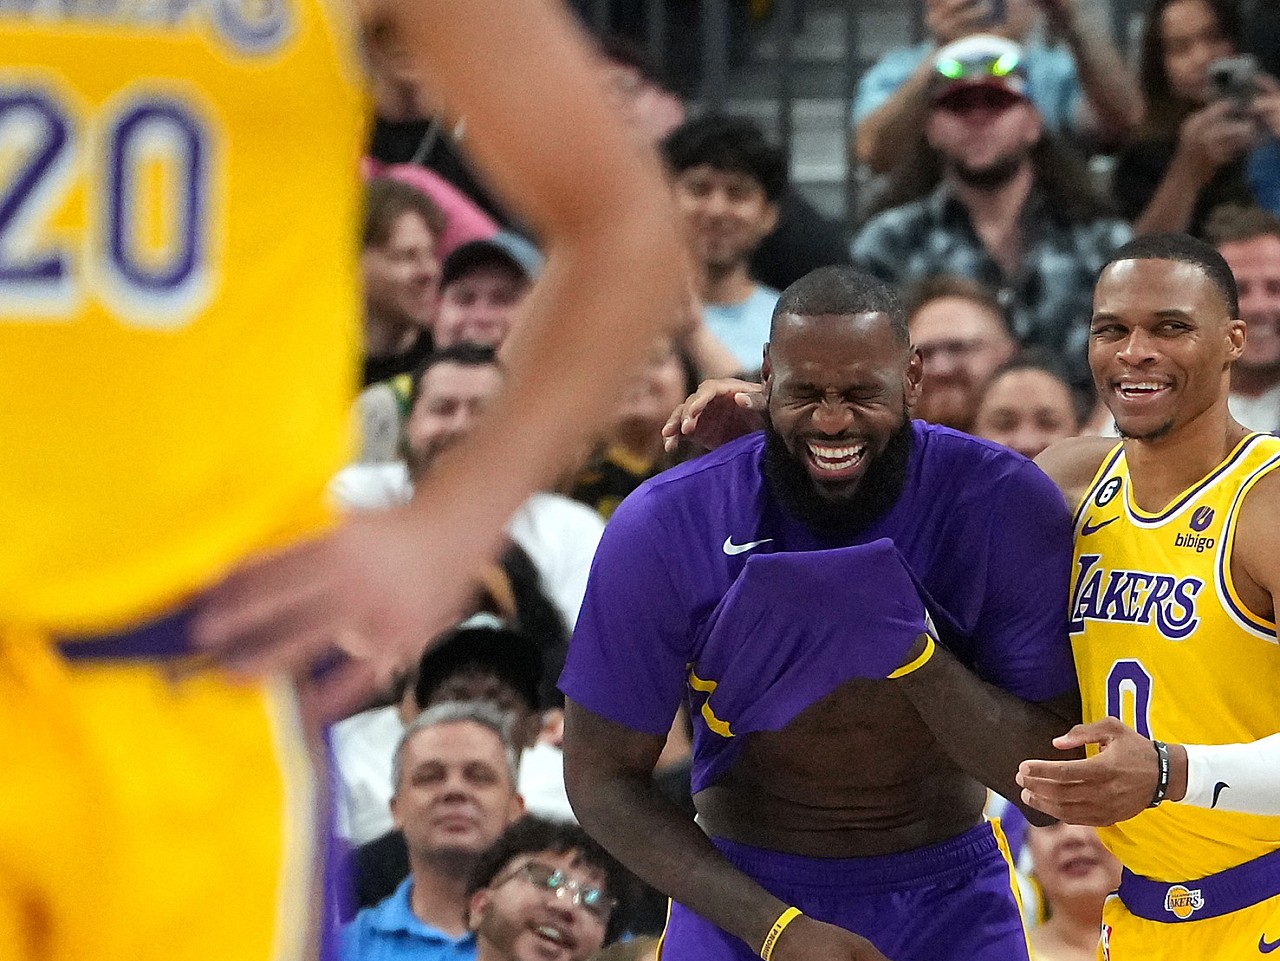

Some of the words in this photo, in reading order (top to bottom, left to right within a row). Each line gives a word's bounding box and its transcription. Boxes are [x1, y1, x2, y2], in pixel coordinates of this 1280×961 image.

[0, 75, 222, 312] 20
[1097, 478, 1120, 505] 6
[1174, 532, 1215, 553] bibigo
[1068, 553, 1206, 642] LAKERS
[1106, 659, 1152, 741] 0
[1167, 894, 1203, 910] LAKERS
